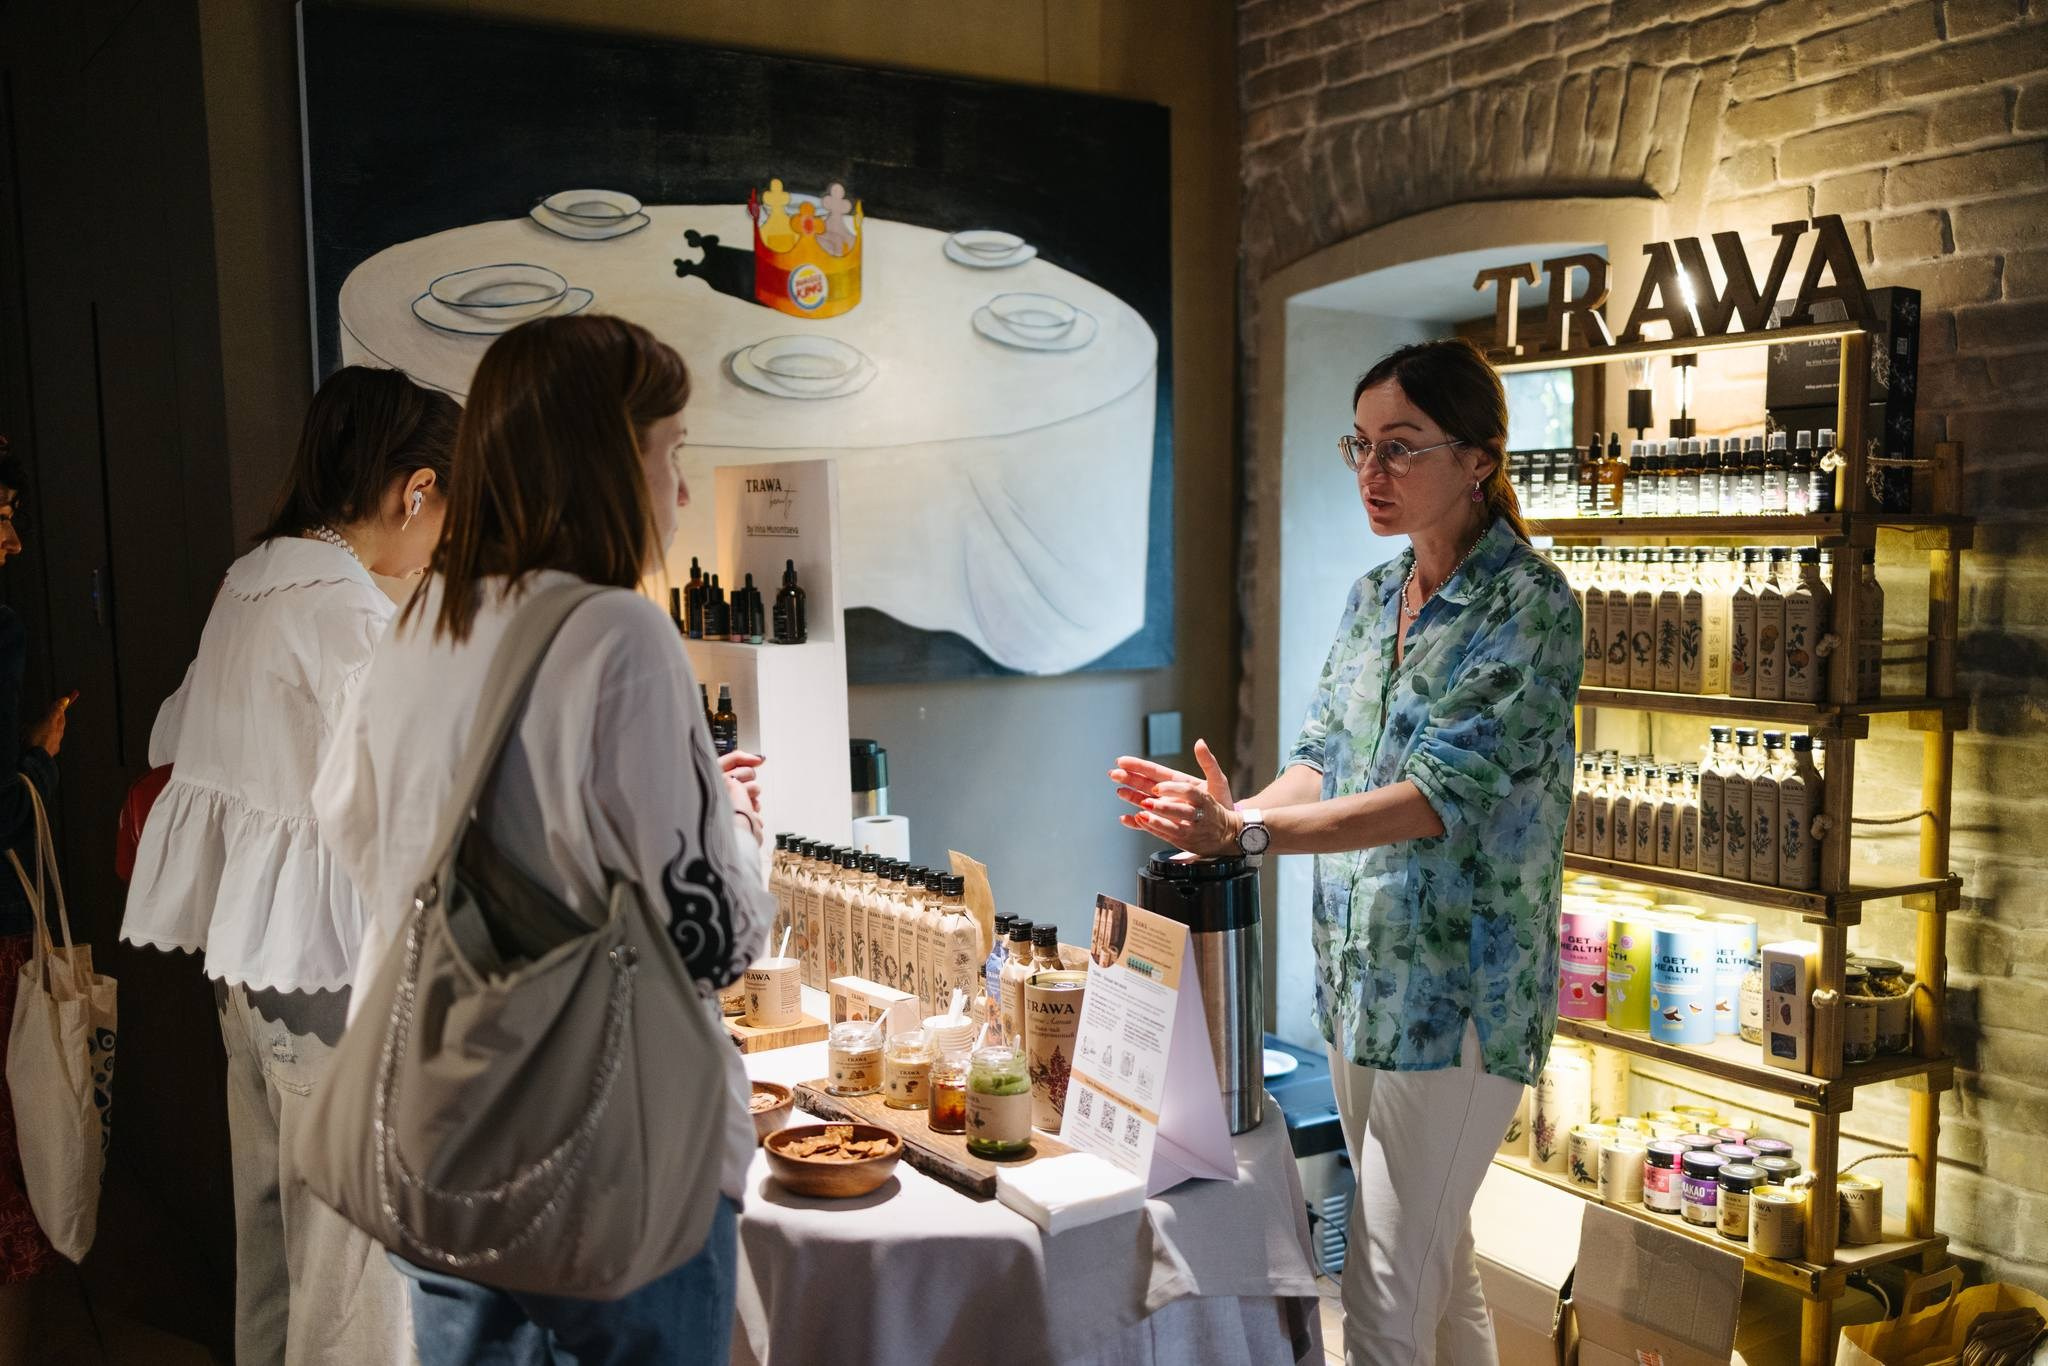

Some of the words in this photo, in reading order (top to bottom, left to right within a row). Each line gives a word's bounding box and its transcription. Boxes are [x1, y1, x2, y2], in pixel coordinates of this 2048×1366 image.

[1473, 214, 1877, 356] TRAWA
[745, 478, 782, 492] TRAWA
[1567, 935, 1590, 945] GET
[1560, 941, 1602, 953] HEALTH
[1716, 948, 1735, 956] ET
[1662, 955, 1686, 965] GET
[1654, 962, 1699, 974] HEALTH
[1027, 999, 1075, 1015] TRAWA
